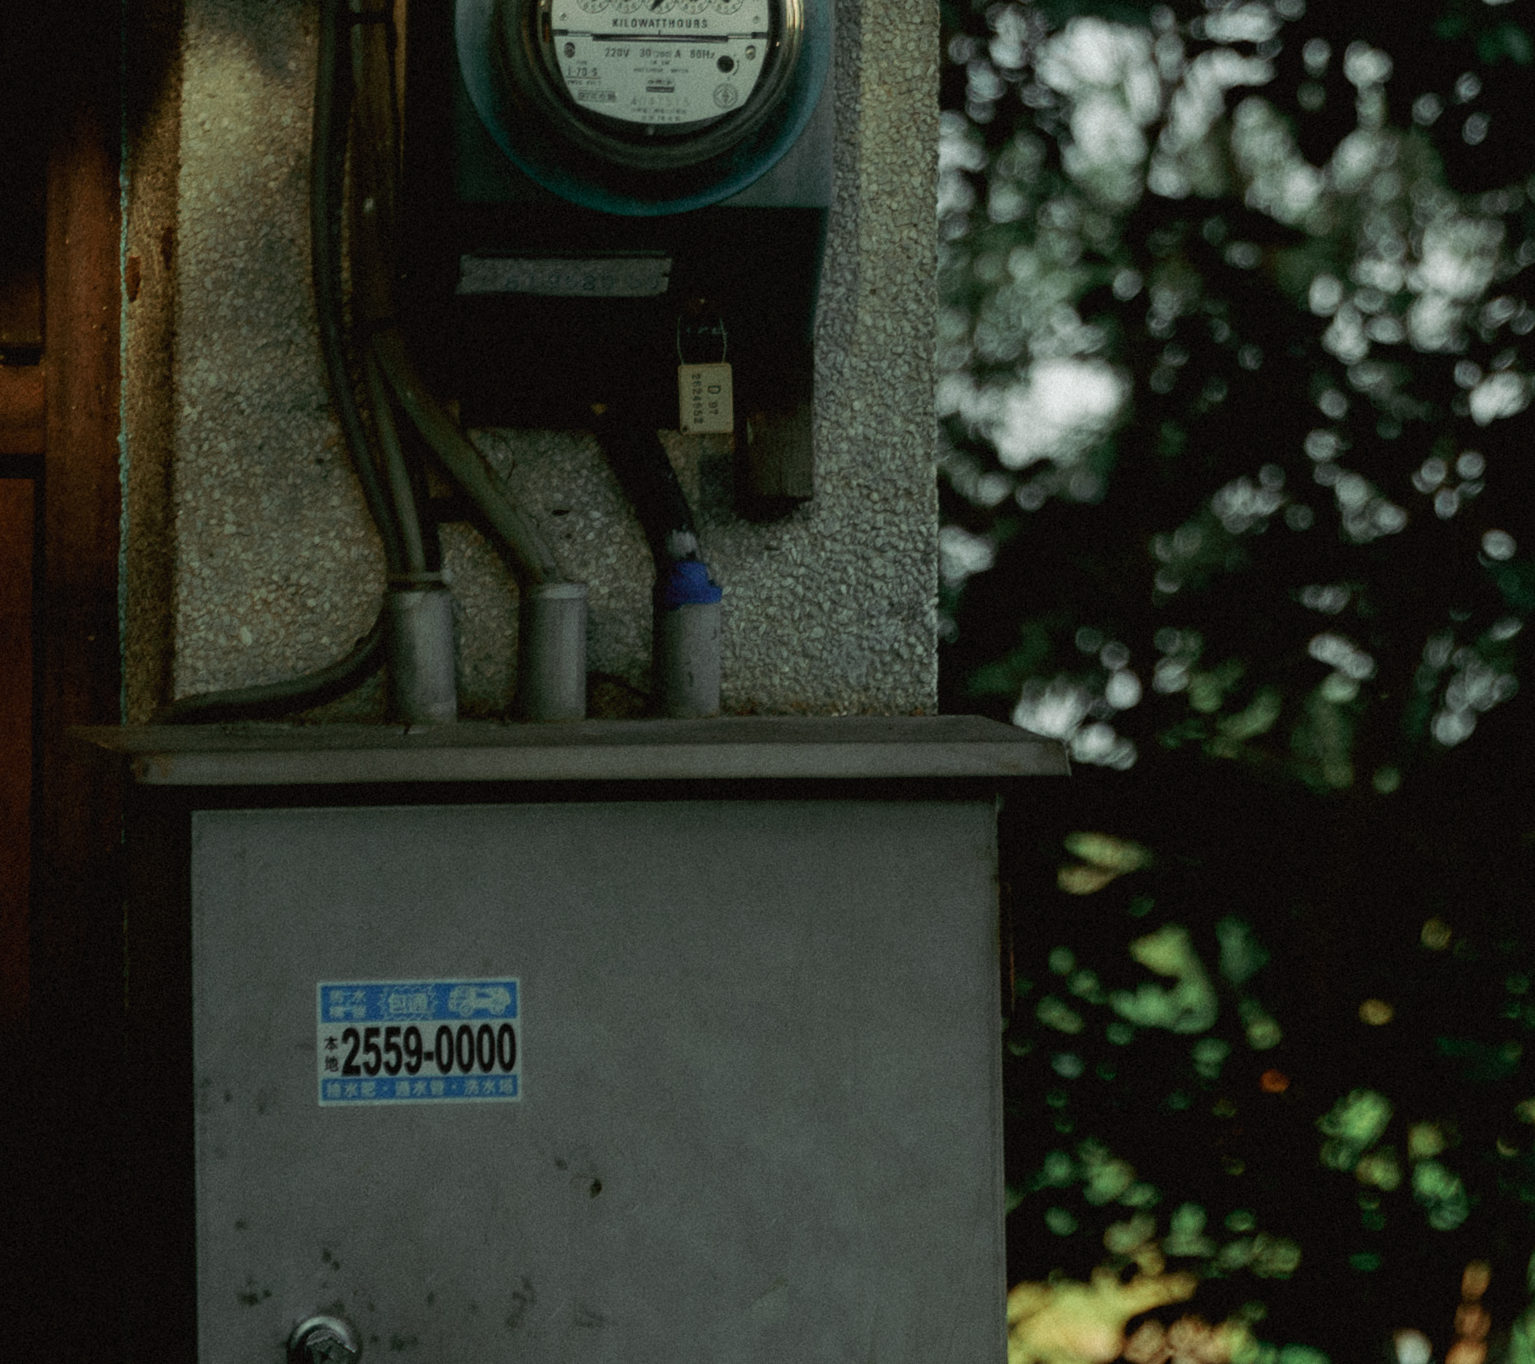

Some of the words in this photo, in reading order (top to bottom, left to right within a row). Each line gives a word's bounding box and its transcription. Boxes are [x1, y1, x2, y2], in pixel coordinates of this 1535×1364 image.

[611, 17, 709, 29] KILOWATTHOURS
[604, 47, 631, 58] 220V
[341, 1022, 517, 1077] 2559-0000
